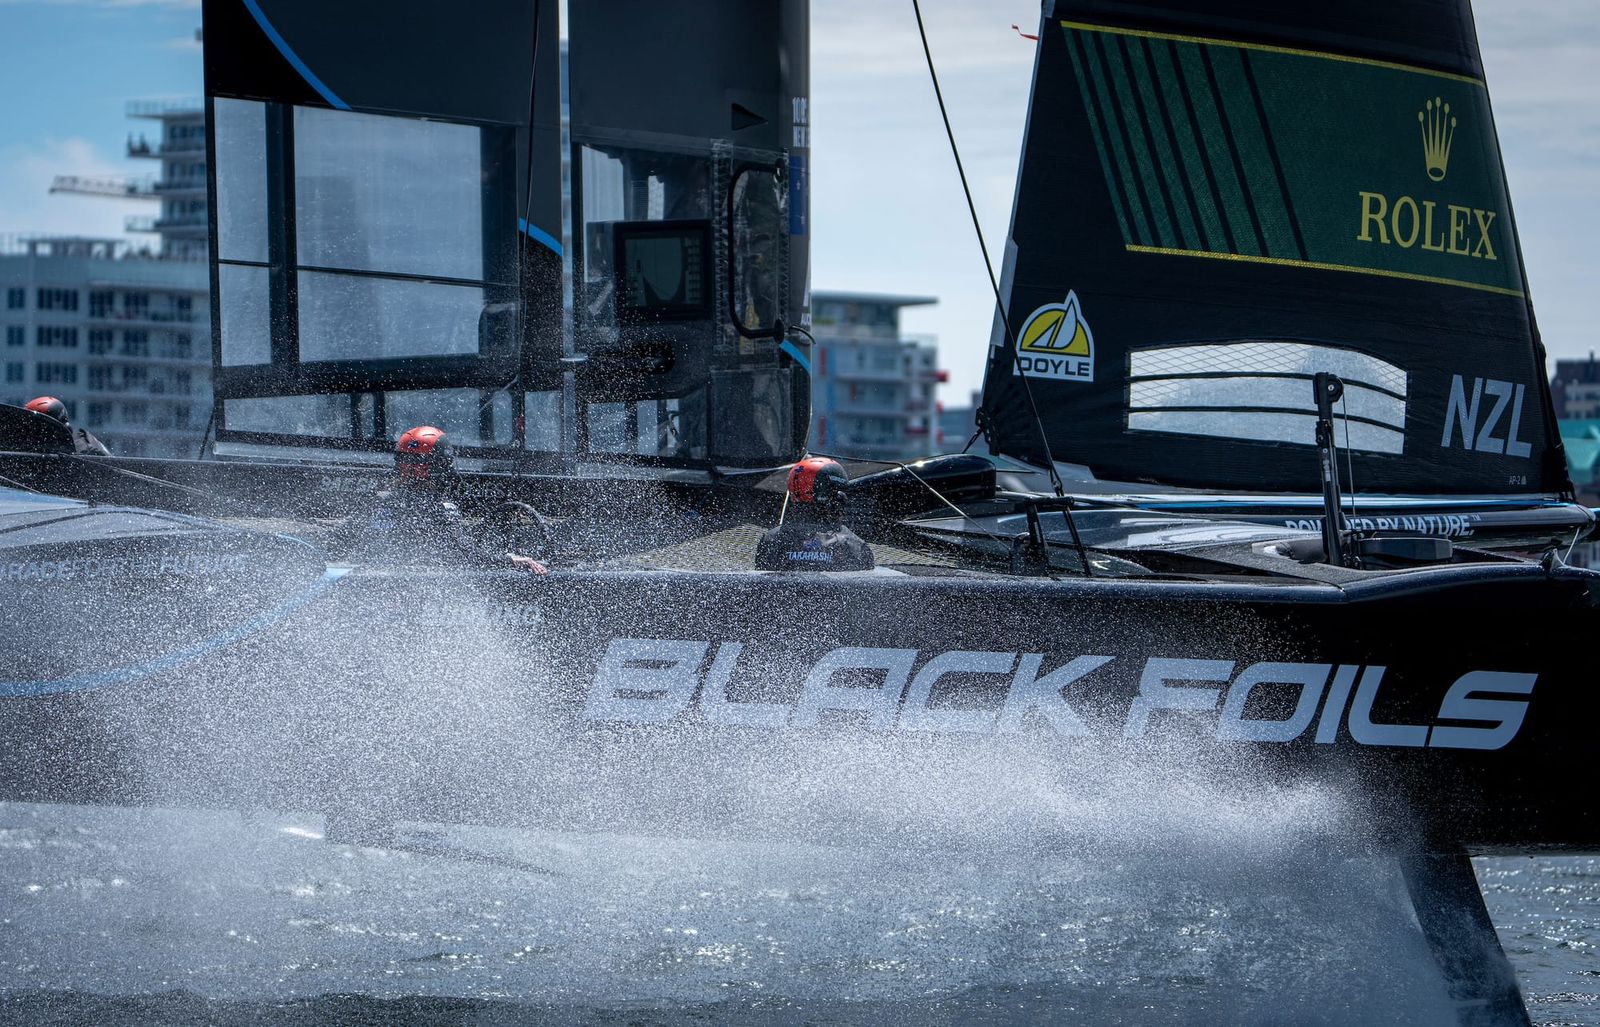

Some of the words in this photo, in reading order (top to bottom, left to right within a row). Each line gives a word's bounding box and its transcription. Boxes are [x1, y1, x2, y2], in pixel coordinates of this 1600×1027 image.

[1357, 190, 1498, 260] ROLEX
[1017, 356, 1090, 376] DOYLE
[1440, 374, 1532, 458] NZL
[1376, 517, 1399, 530] BY
[584, 637, 1113, 736] BLACK
[1123, 657, 1538, 750] FOILS
